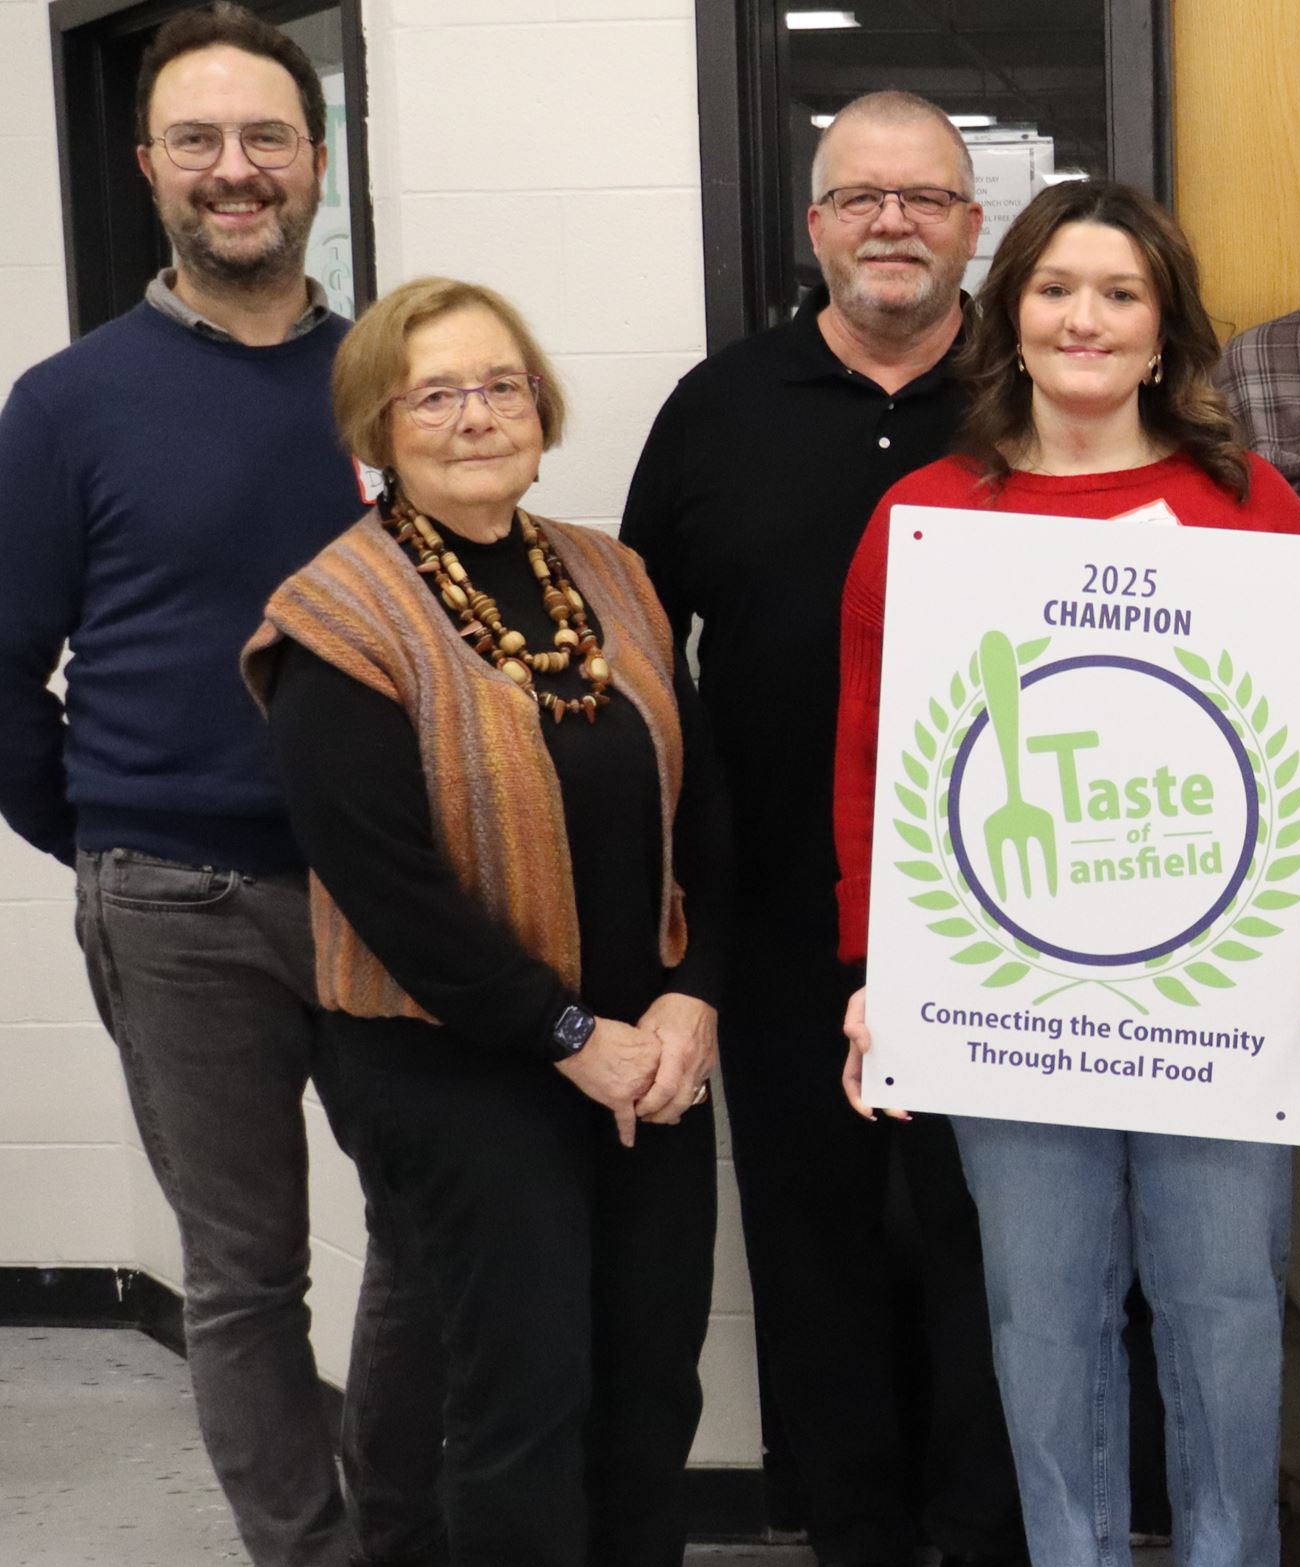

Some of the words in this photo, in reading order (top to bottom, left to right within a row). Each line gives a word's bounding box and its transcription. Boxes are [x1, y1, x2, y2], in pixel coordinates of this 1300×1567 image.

[1082, 564, 1157, 598] 2025
[1043, 599, 1192, 636] CHAMPION
[1026, 730, 1214, 824] Taste
[1127, 822, 1151, 845] of
[920, 1002, 1063, 1039] Connecting
[1070, 1014, 1111, 1039] the
[1118, 1019, 1265, 1057] Community
[967, 1041, 1073, 1075] Through
[1080, 1051, 1145, 1077] Local
[1151, 1058, 1213, 1083] Food
